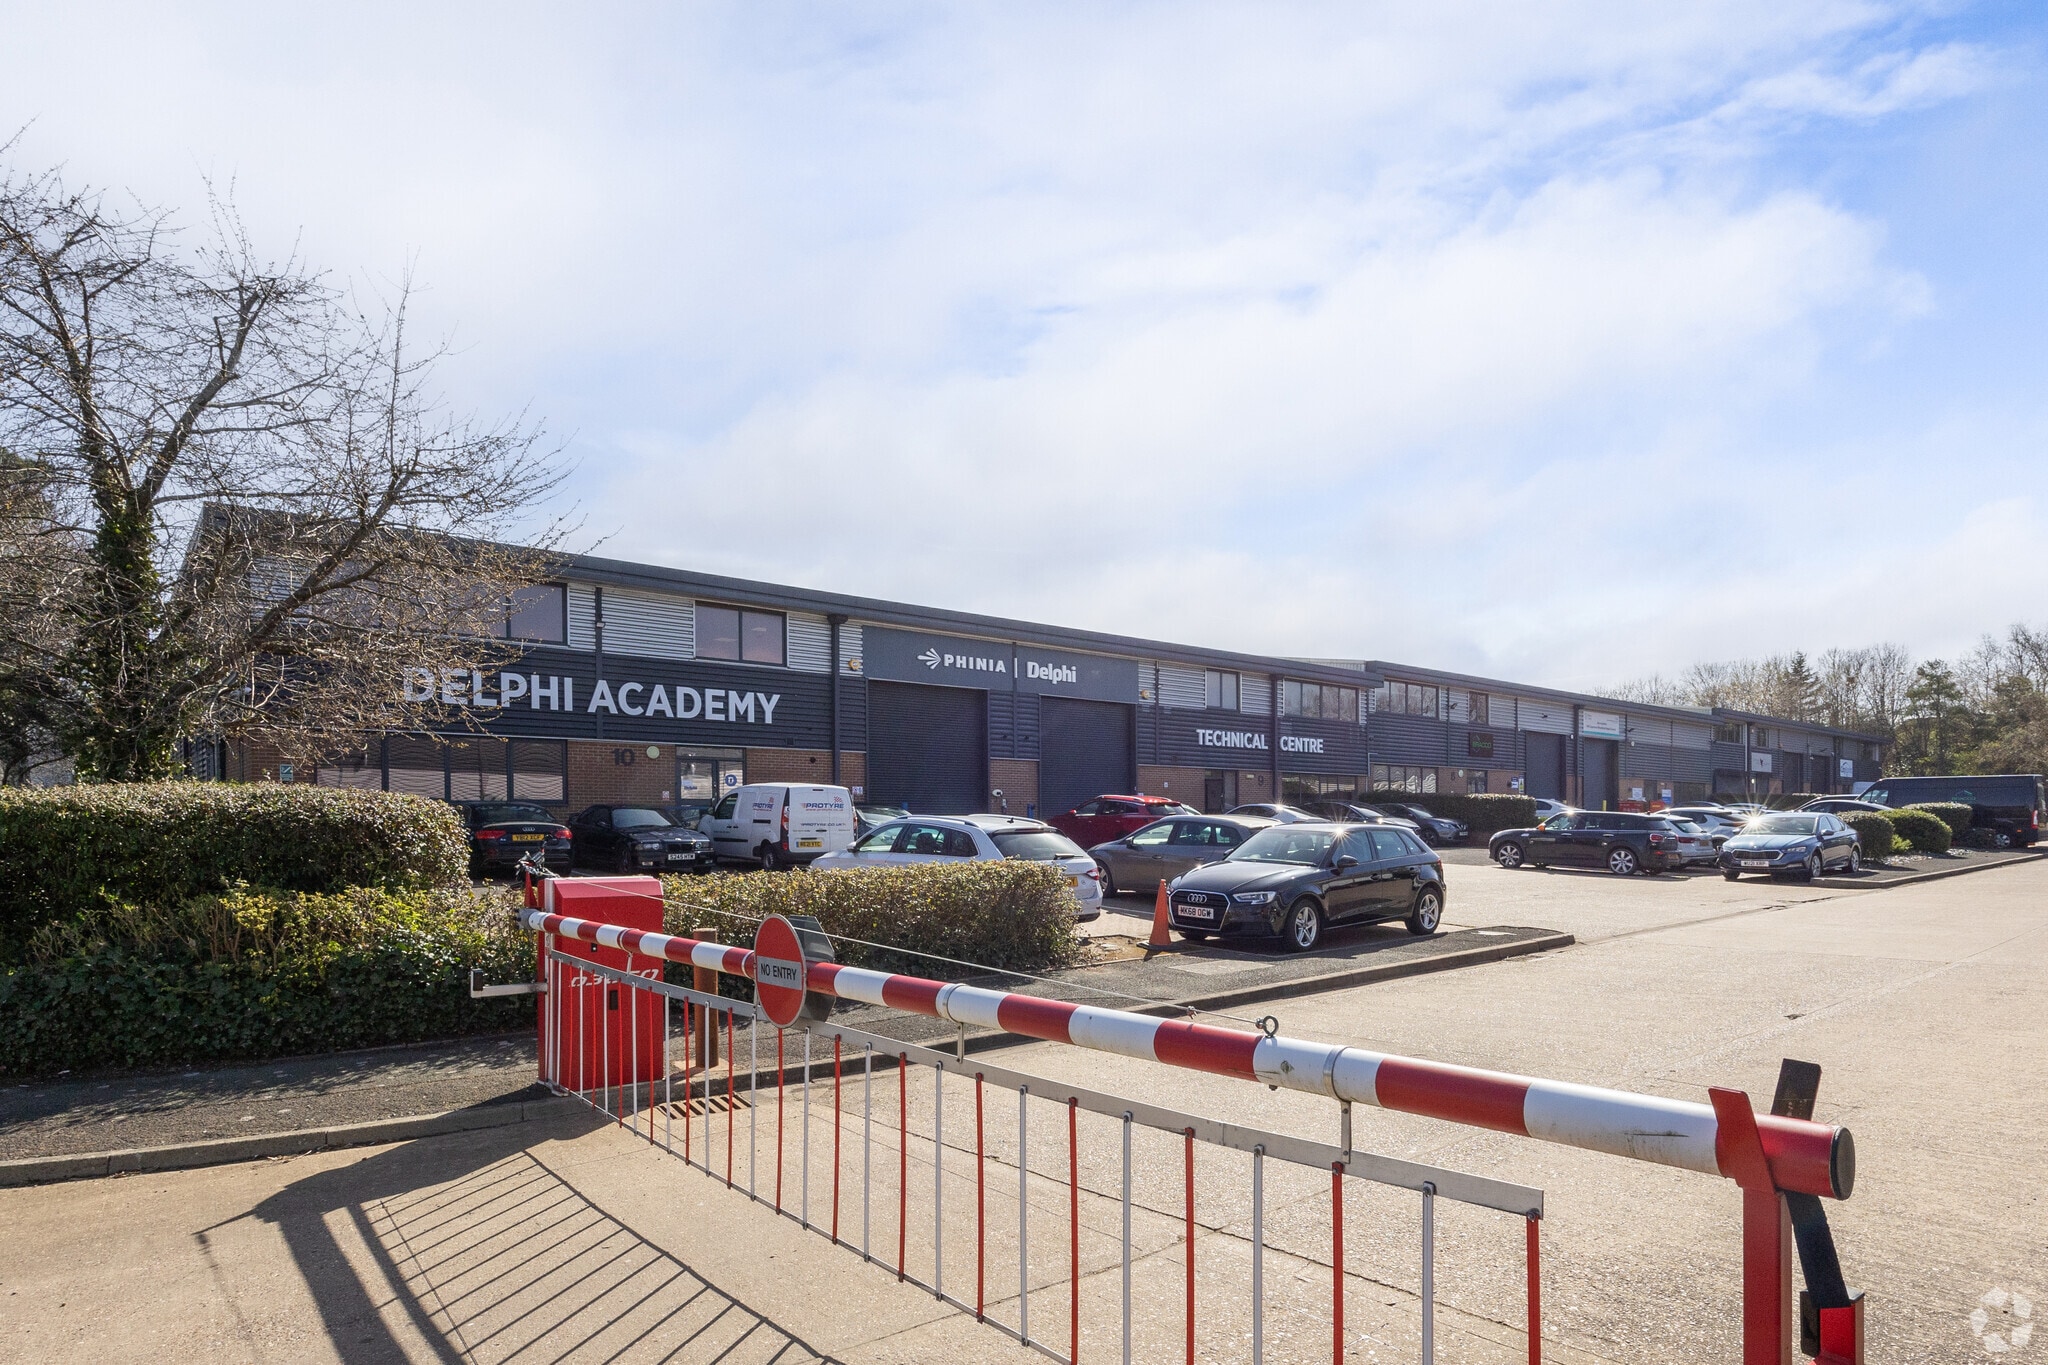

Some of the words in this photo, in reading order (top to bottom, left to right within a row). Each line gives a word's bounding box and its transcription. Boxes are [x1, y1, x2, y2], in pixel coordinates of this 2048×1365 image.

[944, 653, 1006, 673] PHINIA
[1026, 661, 1077, 685] Delphi
[403, 665, 573, 712] DELPHI
[587, 679, 781, 724] ACADEMY
[1196, 729, 1269, 750] TECHNICAL
[1280, 735, 1324, 754] CENTRE
[613, 748, 635, 767] 10
[760, 963, 771, 977] NO
[772, 965, 797, 981] ENTRY
